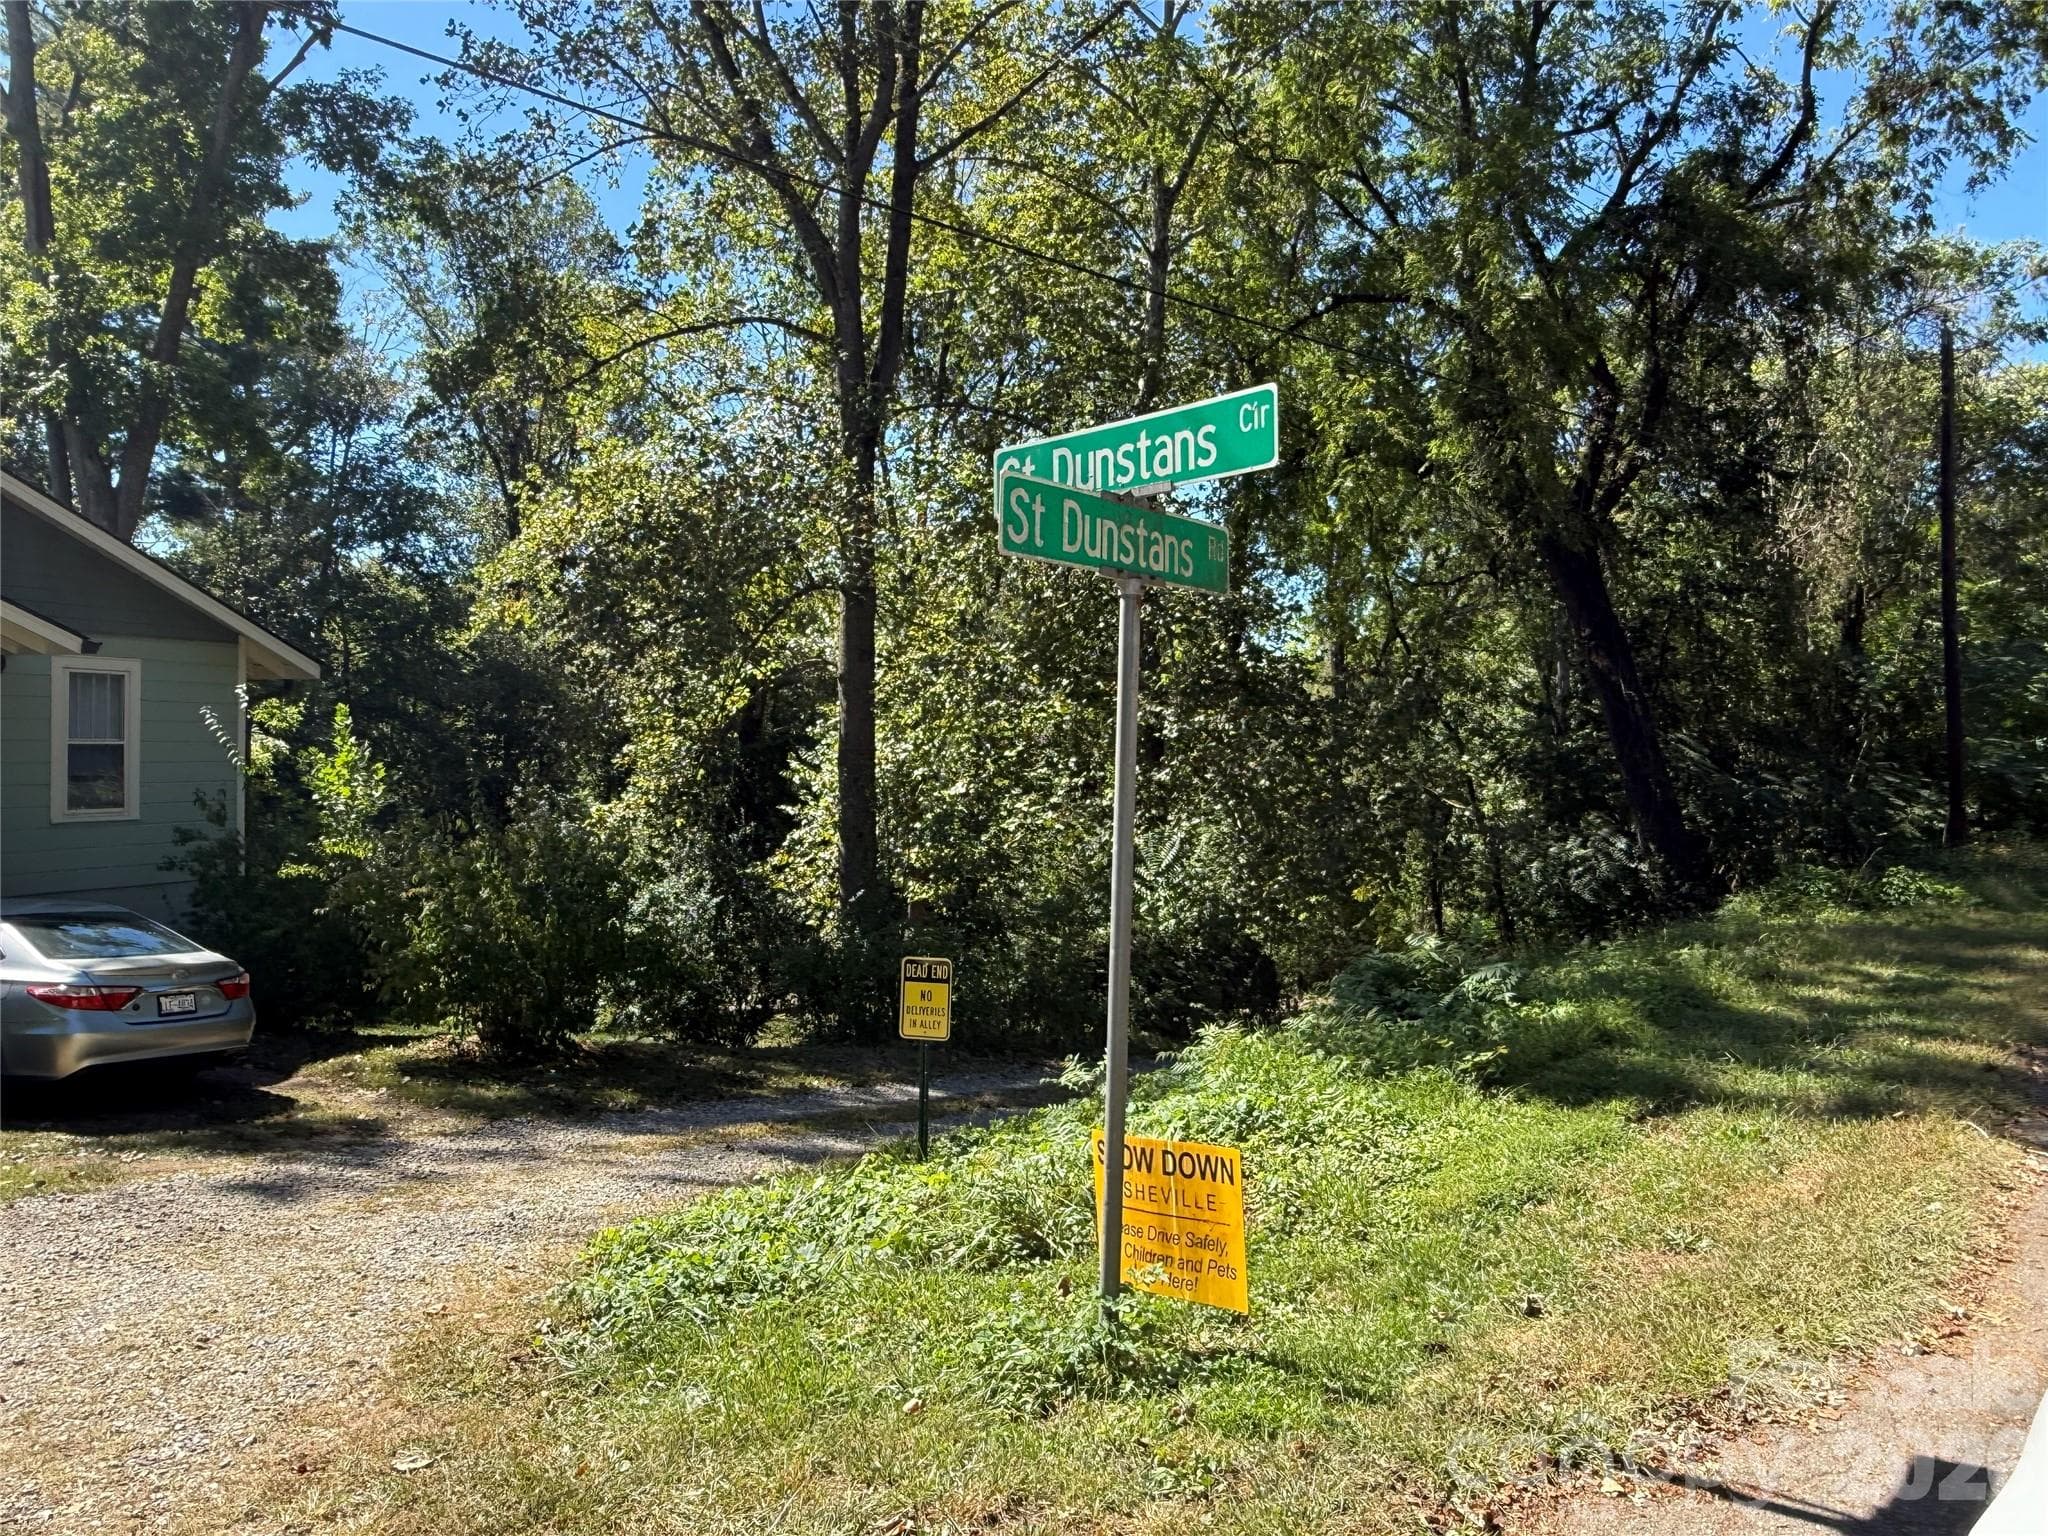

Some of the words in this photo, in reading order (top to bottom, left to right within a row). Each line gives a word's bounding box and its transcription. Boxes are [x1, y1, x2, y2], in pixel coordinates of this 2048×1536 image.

[1052, 424, 1217, 491] Dunstans
[1239, 401, 1270, 433] Cir
[1007, 487, 1046, 548] St
[1062, 498, 1194, 578] Dunstans
[1208, 535, 1224, 563] Rd
[906, 963, 928, 978] DEAD
[931, 965, 948, 979] END
[906, 1005, 946, 1017] DELIVERIES
[920, 989, 933, 1002] NO
[909, 1018, 917, 1029] IN
[919, 1020, 942, 1030] ALLEY
[1097, 1139, 1154, 1174] SOW
[1162, 1149, 1236, 1186] DOWN
[1123, 1181, 1218, 1212] SHEVILLE
[1122, 1223, 1144, 1239] ase
[1147, 1225, 1181, 1246] Drive
[1185, 1231, 1229, 1257] Safely,
[1124, 1242, 1174, 1268] Children
[1177, 1258, 1203, 1274] and
[1207, 1259, 1238, 1281] Pets
